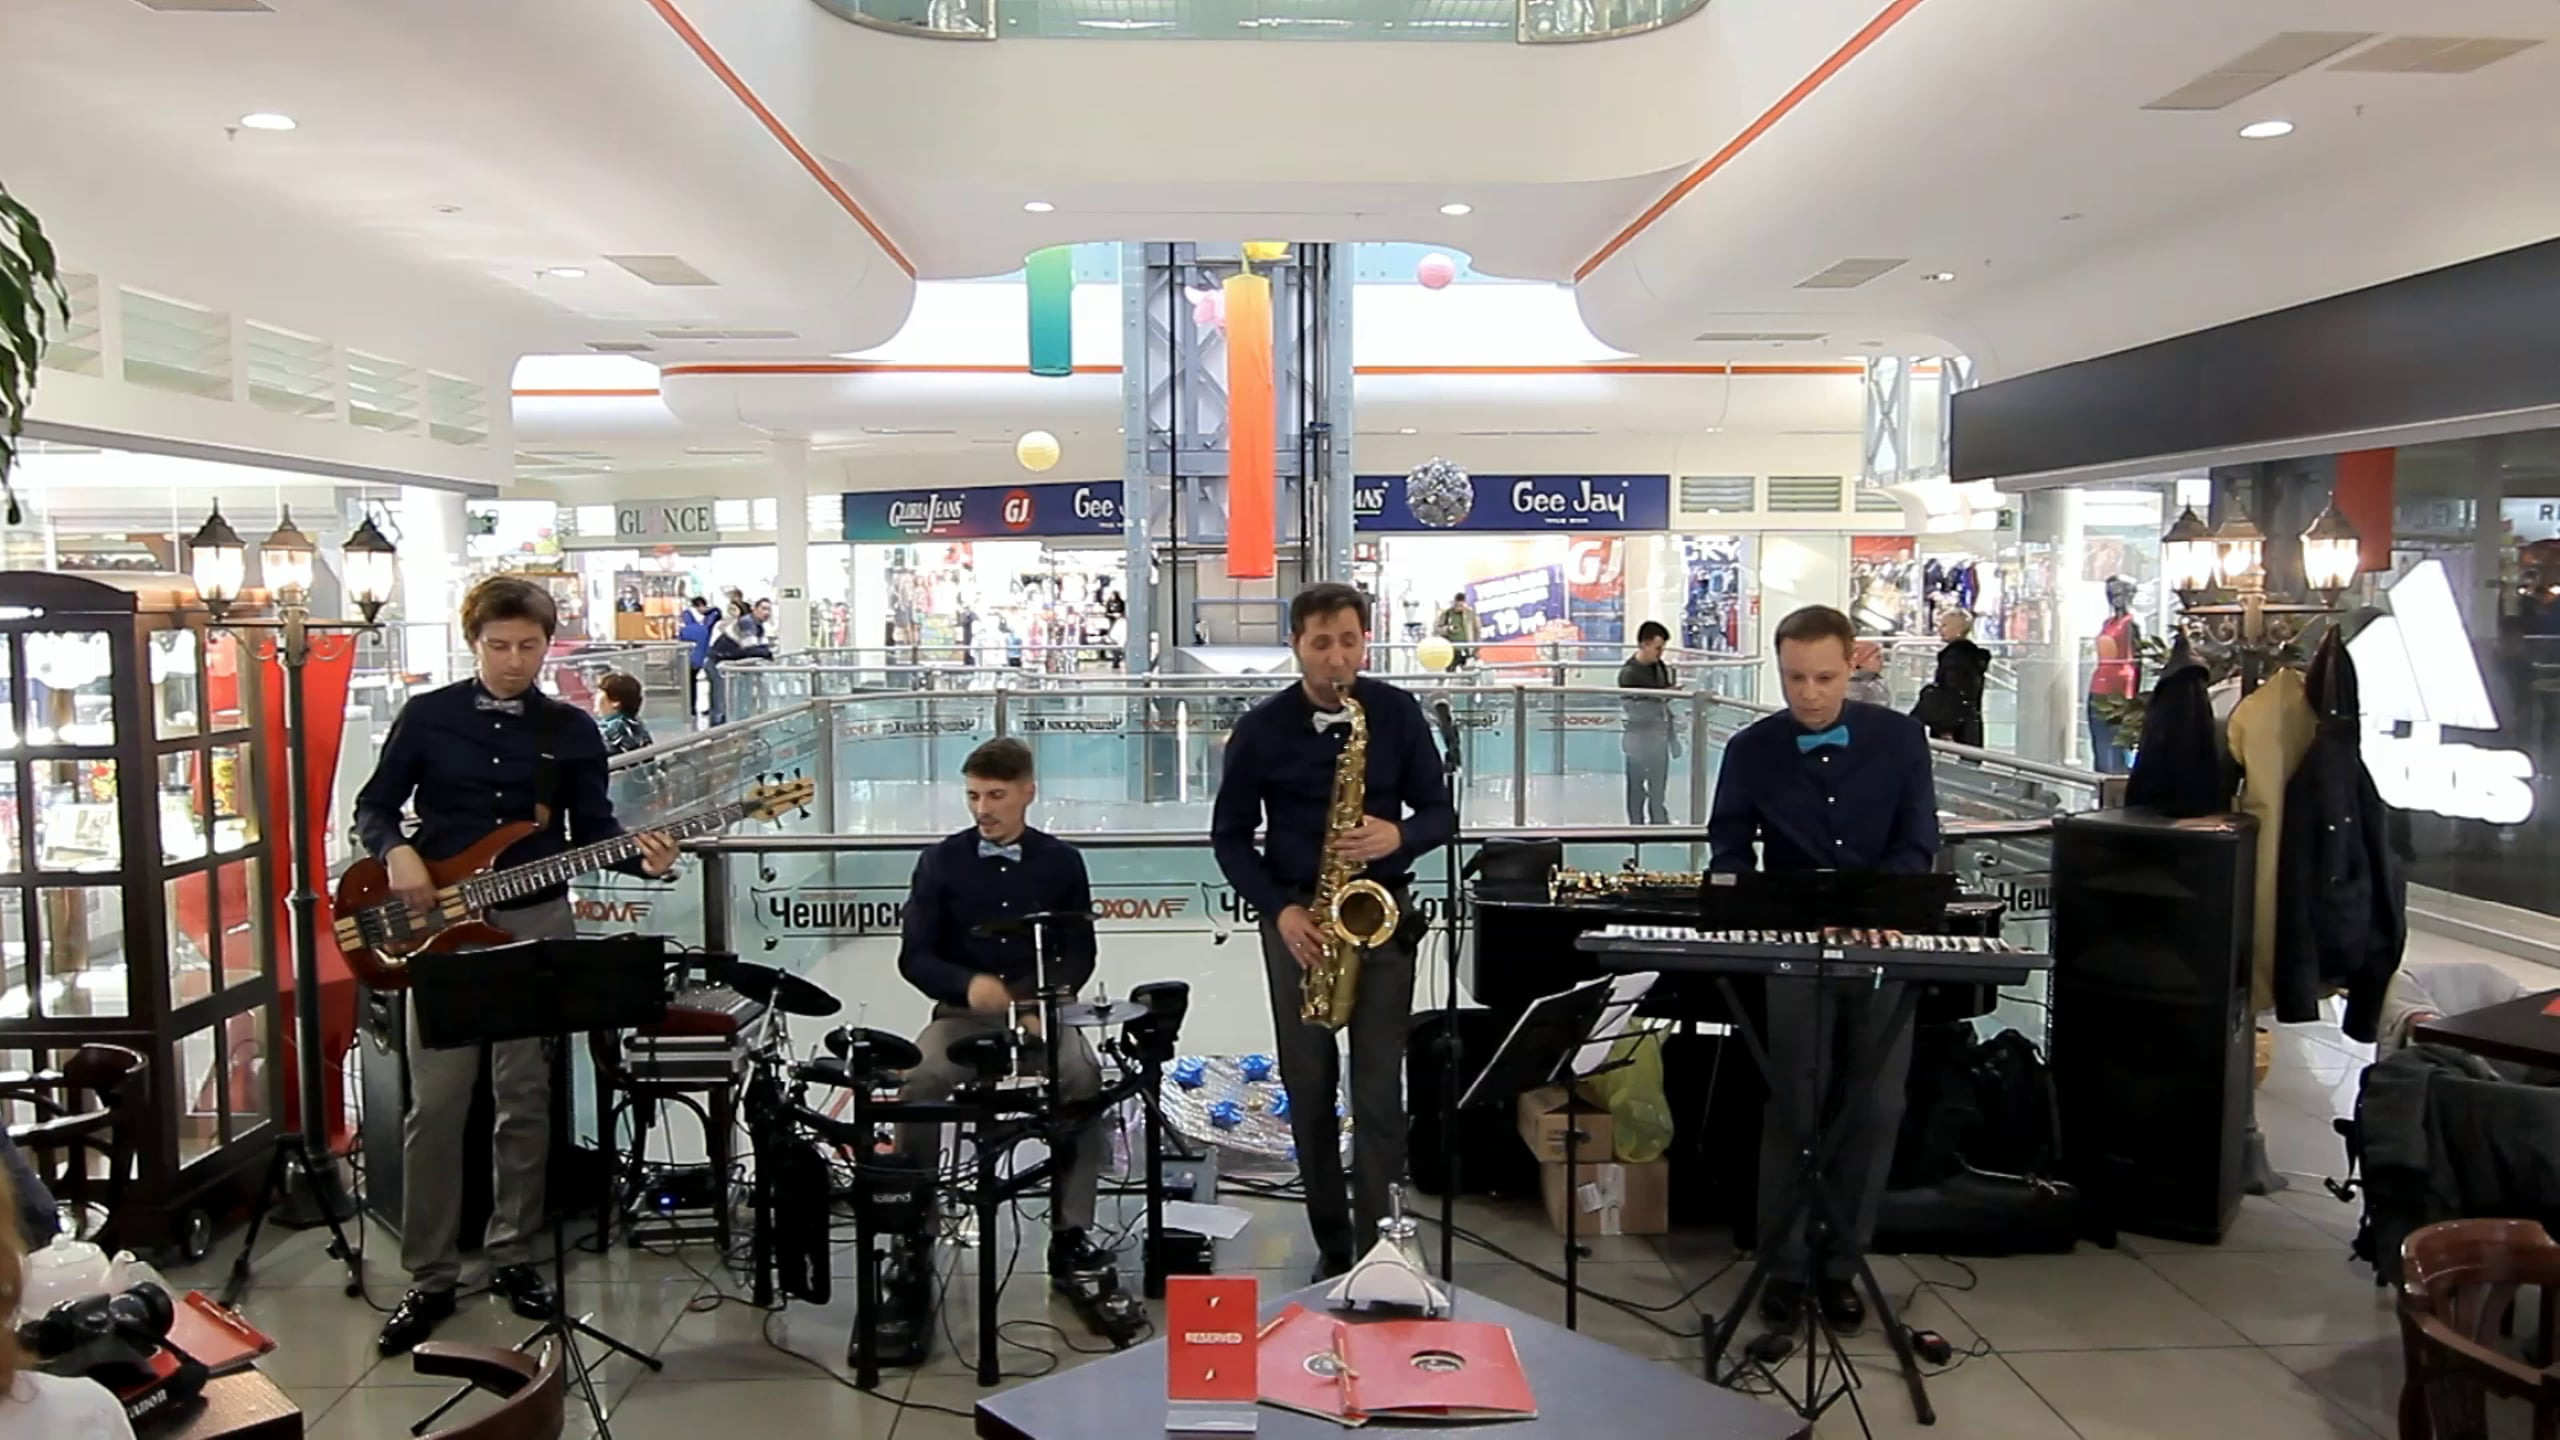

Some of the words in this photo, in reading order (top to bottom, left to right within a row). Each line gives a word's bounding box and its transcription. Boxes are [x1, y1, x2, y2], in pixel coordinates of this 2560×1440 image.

[1075, 488, 1114, 518] Gee
[1513, 481, 1566, 513] Gee
[1573, 480, 1628, 521] Jay
